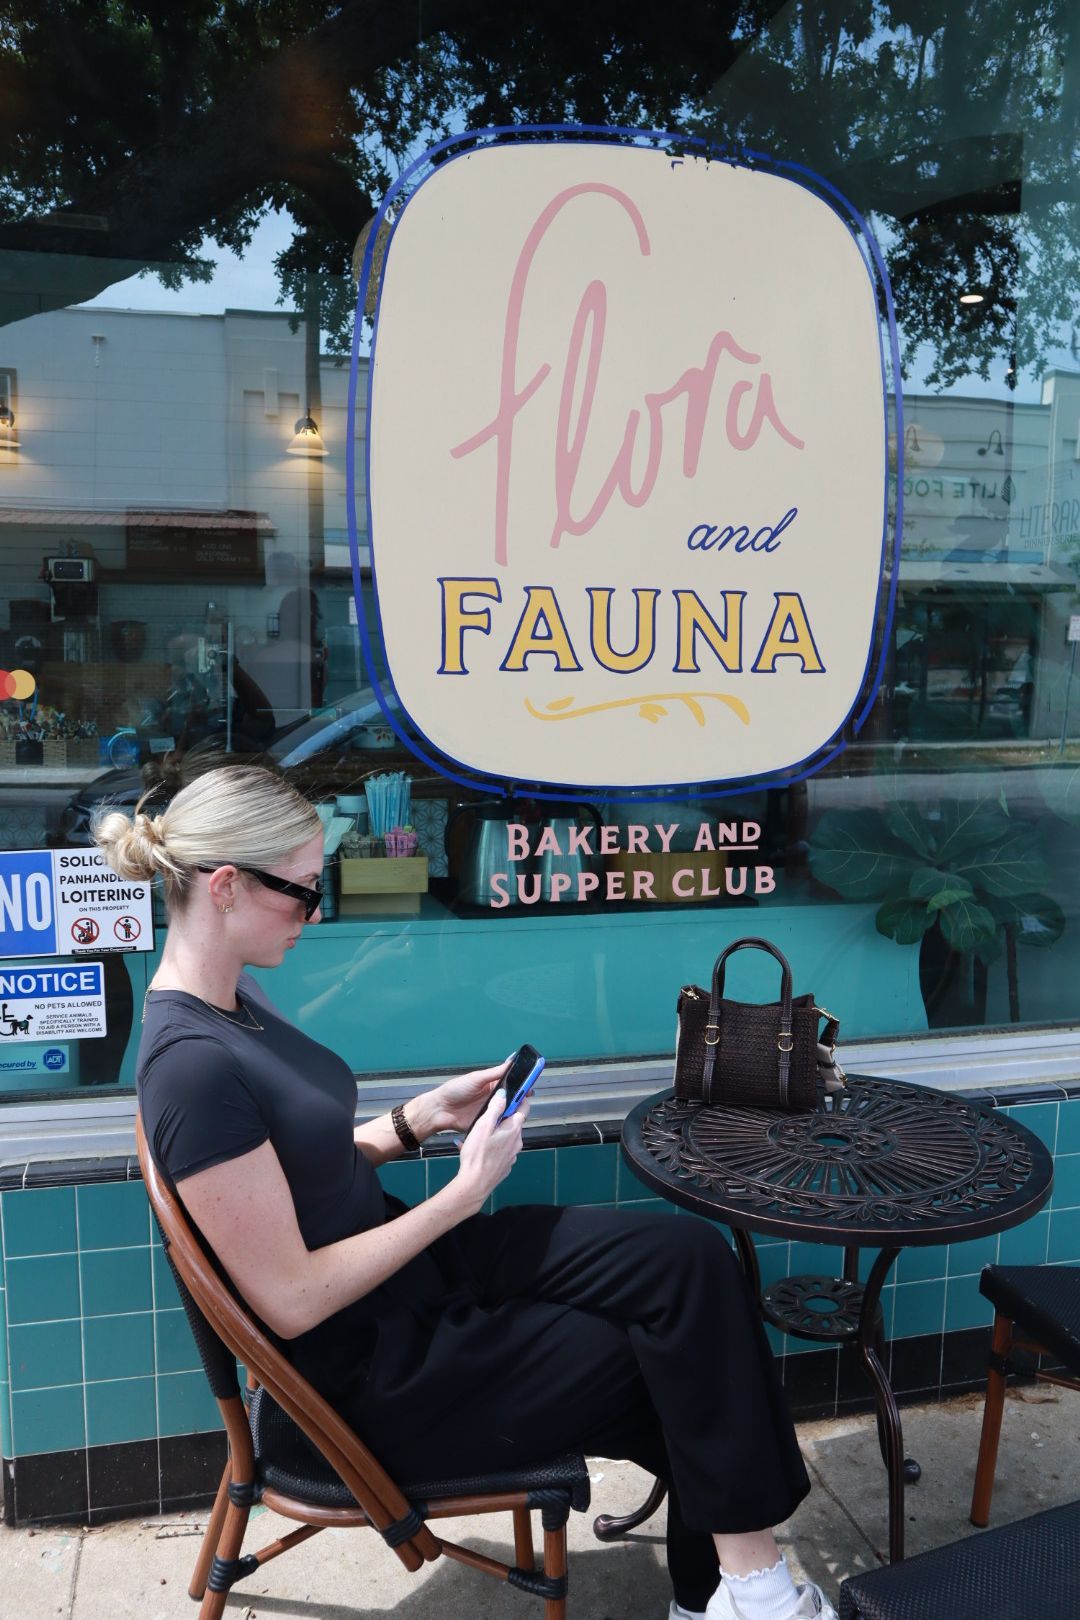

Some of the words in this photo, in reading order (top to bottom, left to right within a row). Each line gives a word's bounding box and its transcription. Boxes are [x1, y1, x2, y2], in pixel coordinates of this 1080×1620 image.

[687, 507, 798, 553] and
[436, 576, 827, 676] FAUNA
[506, 823, 680, 862] BAKERY
[693, 822, 762, 852] AND
[0, 872, 51, 932] NO
[61, 888, 145, 903] LOITERING
[490, 871, 658, 909] SUPPER
[671, 866, 777, 898] CLUB
[0, 972, 95, 994] NOTICE
[67, 1000, 102, 1008] ALLOWED
[27, 1060, 36, 1068] by
[47, 1055, 62, 1064] ADT
